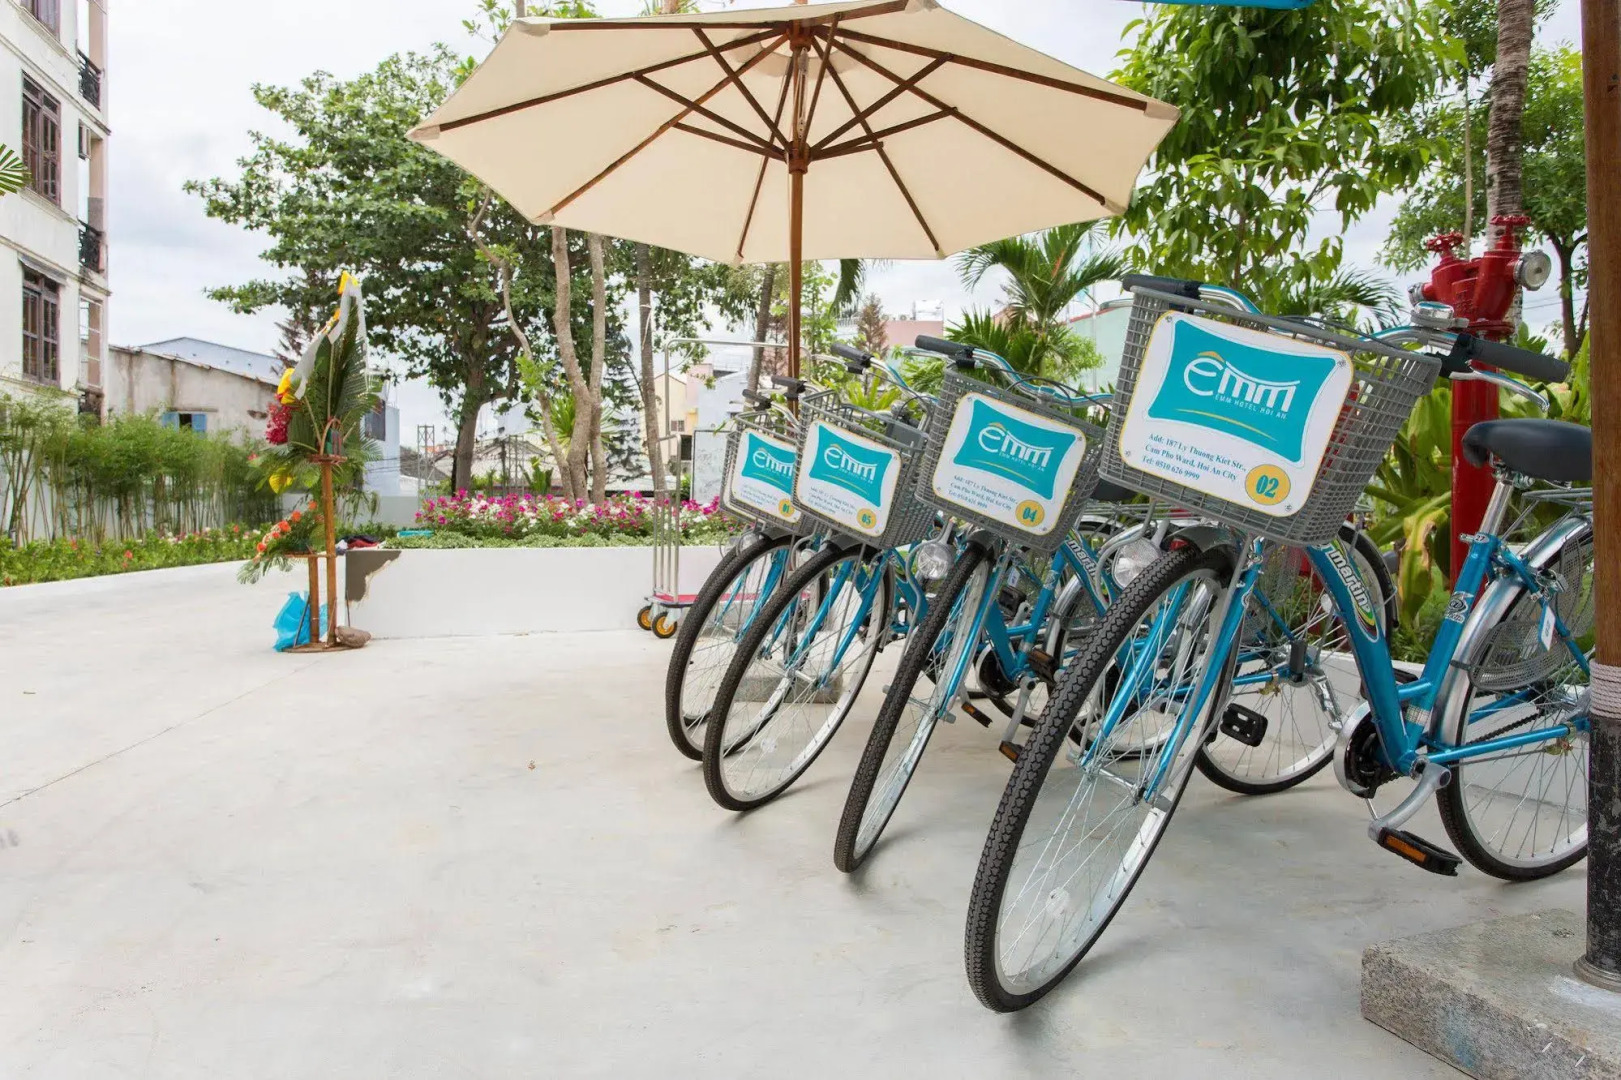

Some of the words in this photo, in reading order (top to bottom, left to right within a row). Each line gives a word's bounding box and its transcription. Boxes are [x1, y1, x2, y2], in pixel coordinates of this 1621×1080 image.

[1233, 399, 1257, 412] HOTEL
[1260, 407, 1274, 416] HOI
[1276, 411, 1287, 420] AN
[1145, 444, 1160, 455] Cam
[1162, 449, 1175, 460] Pho
[1175, 454, 1196, 468] Ward,
[1197, 461, 1210, 472] Hoi
[1211, 466, 1221, 476] An
[1222, 469, 1238, 481] City
[1149, 433, 1164, 445] Add:
[1166, 438, 1178, 448] 187
[1178, 442, 1188, 453] Ly
[1189, 446, 1215, 462] Thuong
[1215, 453, 1231, 466] Kiet
[1142, 455, 1154, 466] Tel:
[1155, 460, 1171, 471] 0510
[1171, 465, 1183, 475] 626
[1184, 469, 1200, 481] 9999
[1256, 474, 1279, 498] 02
[862, 513, 871, 525] 05
[1023, 507, 1037, 522] 04
[1068, 540, 1096, 578] marti
[1328, 550, 1369, 607] martin
